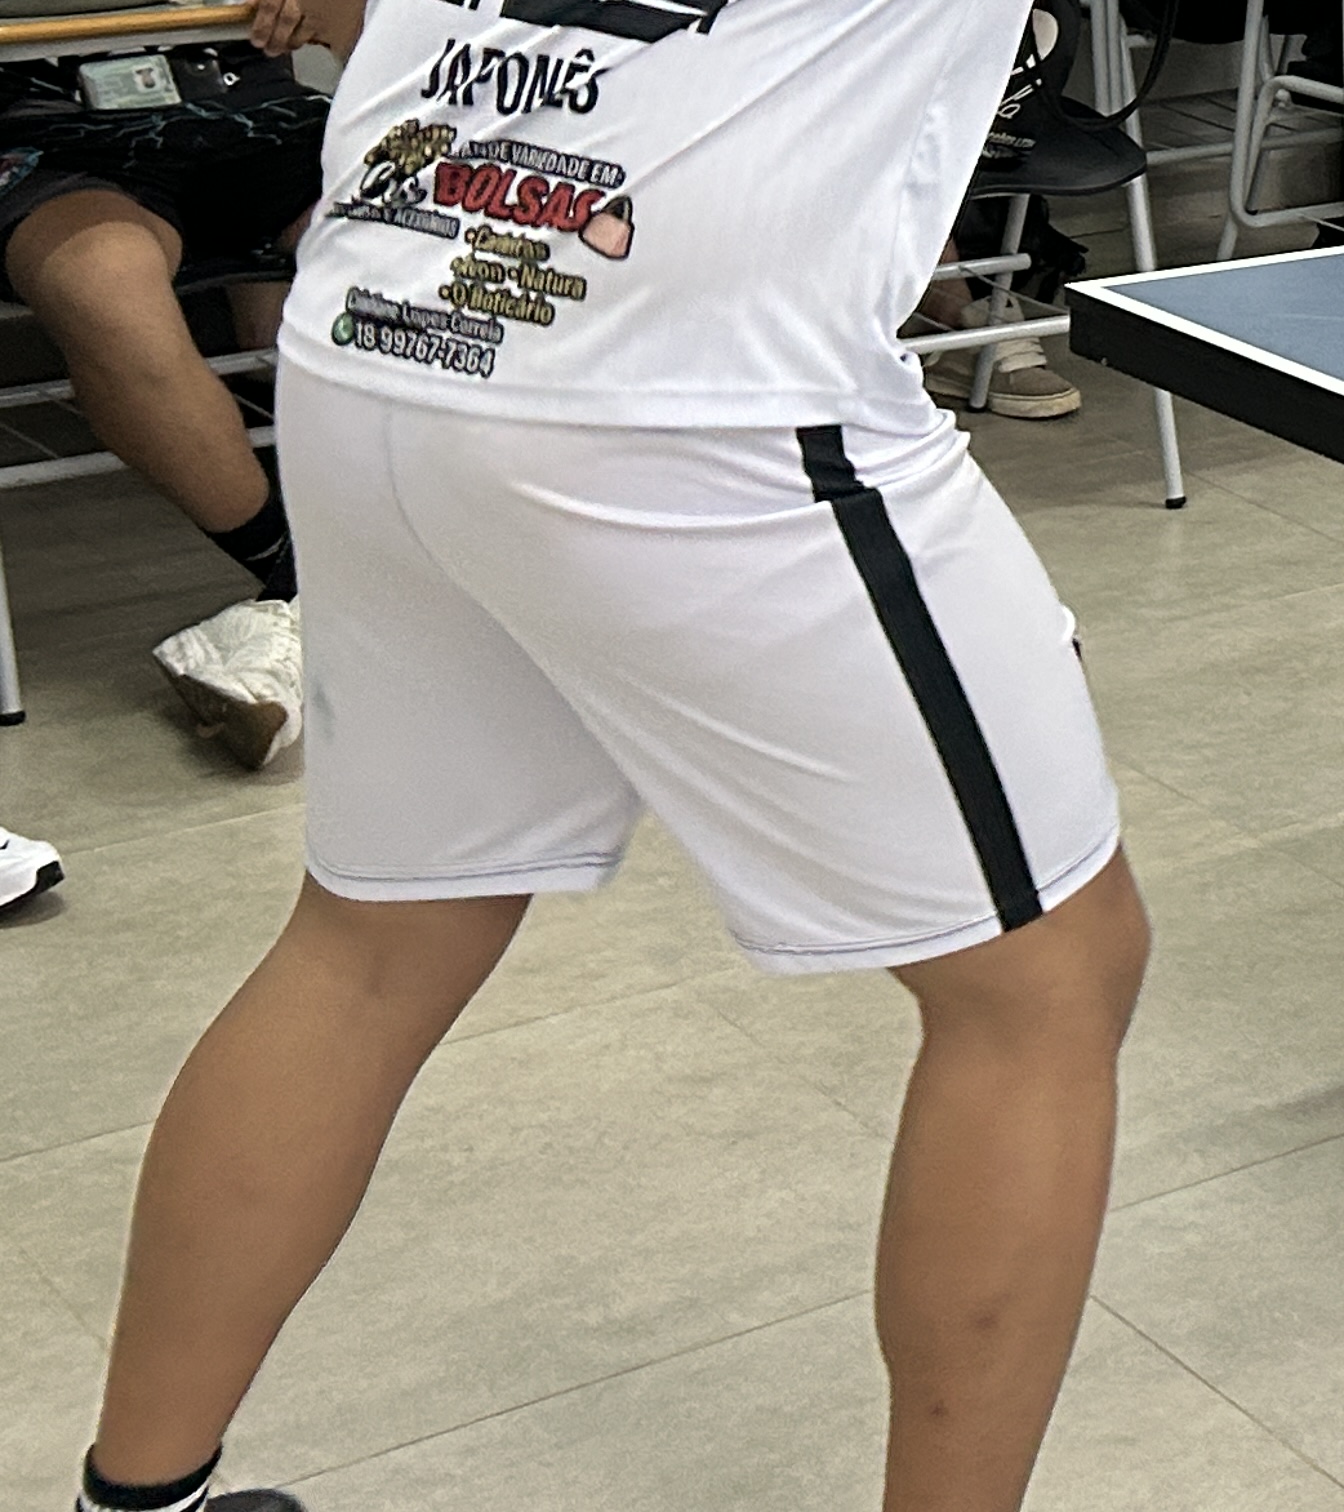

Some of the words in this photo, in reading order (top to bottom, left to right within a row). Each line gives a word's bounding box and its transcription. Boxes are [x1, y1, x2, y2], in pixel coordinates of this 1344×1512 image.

[421, 38, 609, 116] JAPONÊS
[433, 161, 605, 232] BOLSAS
[520, 262, 587, 300] Natura
[355, 322, 376, 350] 18
